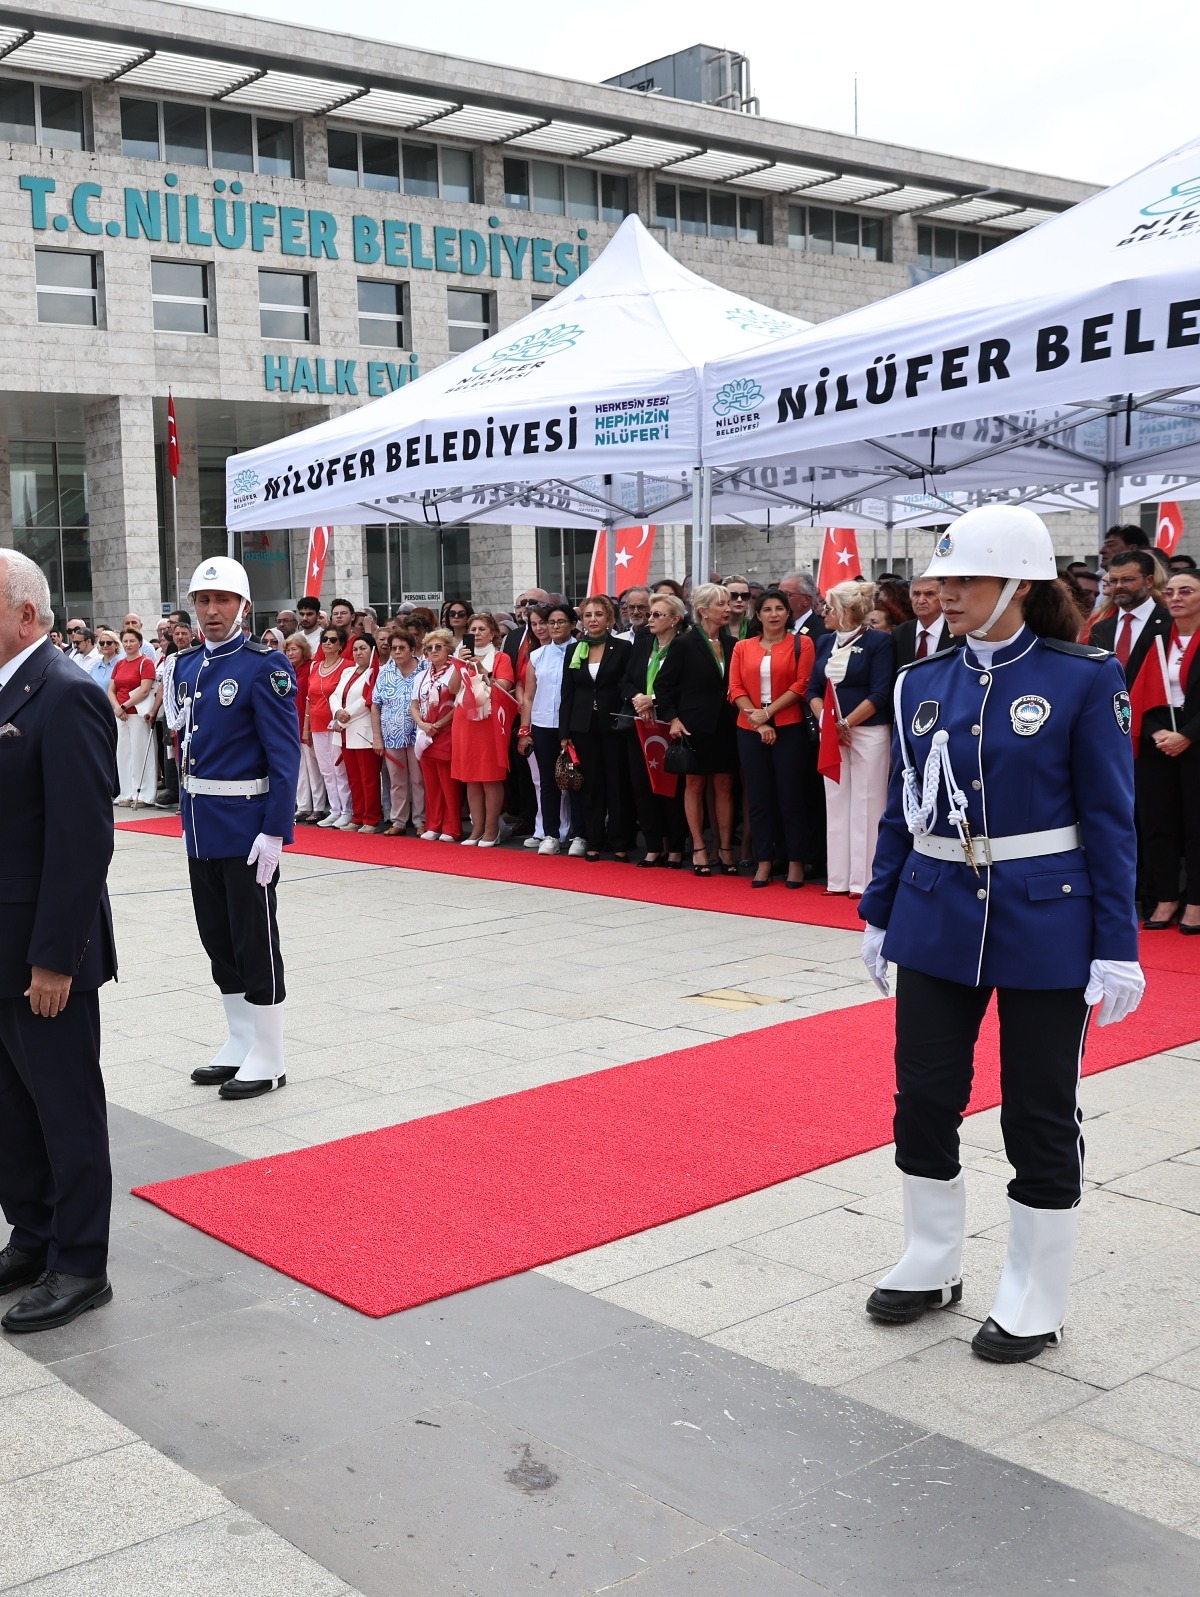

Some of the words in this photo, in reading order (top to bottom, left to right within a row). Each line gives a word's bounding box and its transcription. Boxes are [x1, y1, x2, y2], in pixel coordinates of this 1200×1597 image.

[353, 214, 589, 287] BELEDİYESİ
[264, 354, 359, 395] HALK
[368, 353, 420, 397] EVİ
[777, 338, 1011, 424] NİLÜFER
[595, 398, 645, 413] HERKESİN
[646, 395, 670, 407] SESİ
[595, 408, 670, 430] HEPİMİZİN
[716, 412, 760, 428] NİLÜFER
[716, 421, 760, 437] BELEDİYESİ
[263, 448, 375, 502] NİLÜFER
[386, 405, 578, 473] BELEDİYESİ
